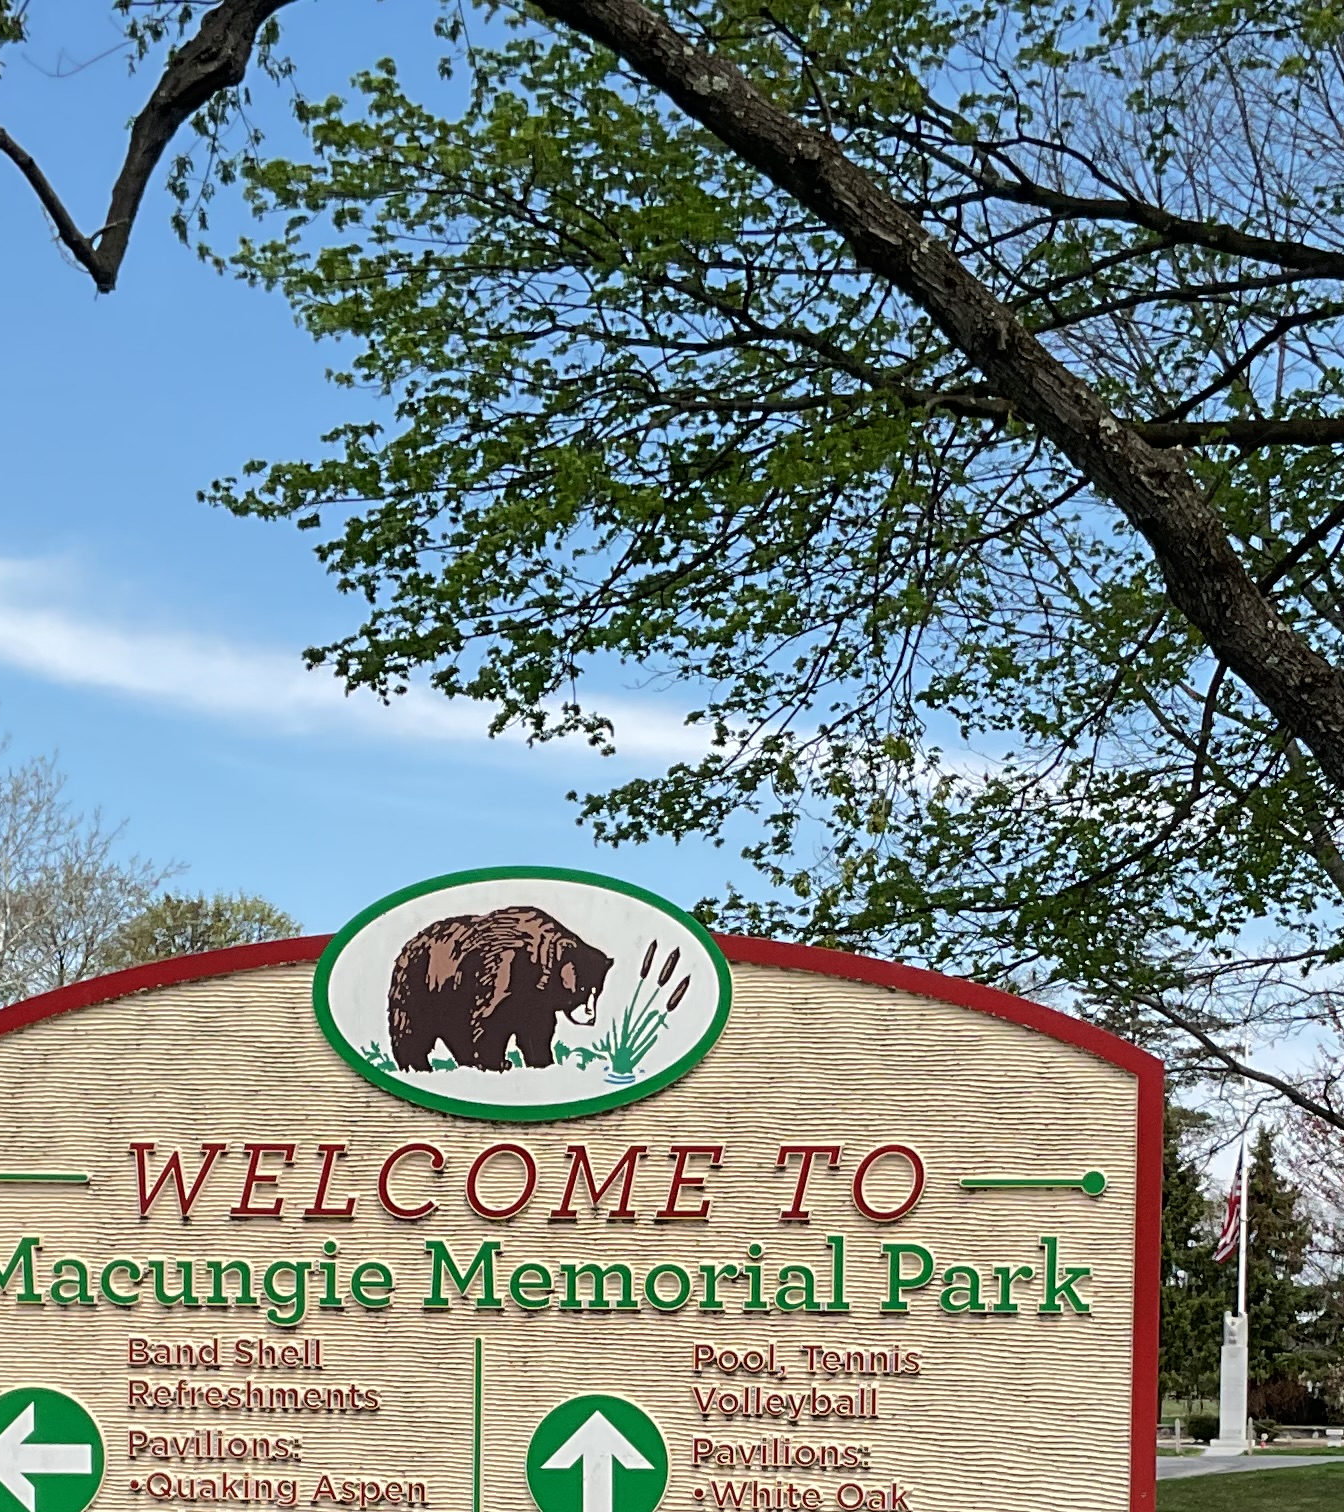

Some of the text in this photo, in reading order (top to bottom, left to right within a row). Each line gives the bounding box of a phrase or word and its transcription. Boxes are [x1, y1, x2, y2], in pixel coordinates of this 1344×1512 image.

[129, 1142, 927, 1222] WELCOME TO
[423, 1235, 851, 1313] Memorial
[879, 1236, 1094, 1314] Park
[128, 1338, 323, 1369] Band Shell
[693, 1343, 922, 1377] Pool, Tennis
[128, 1379, 381, 1411] Refreshments
[693, 1386, 880, 1420] Volleyball
[128, 1430, 301, 1460] Pavilions:
[693, 1437, 871, 1467] Pavilions:
[313, 1475, 428, 1508] Aspen
[837, 1482, 913, 1512] Oak
